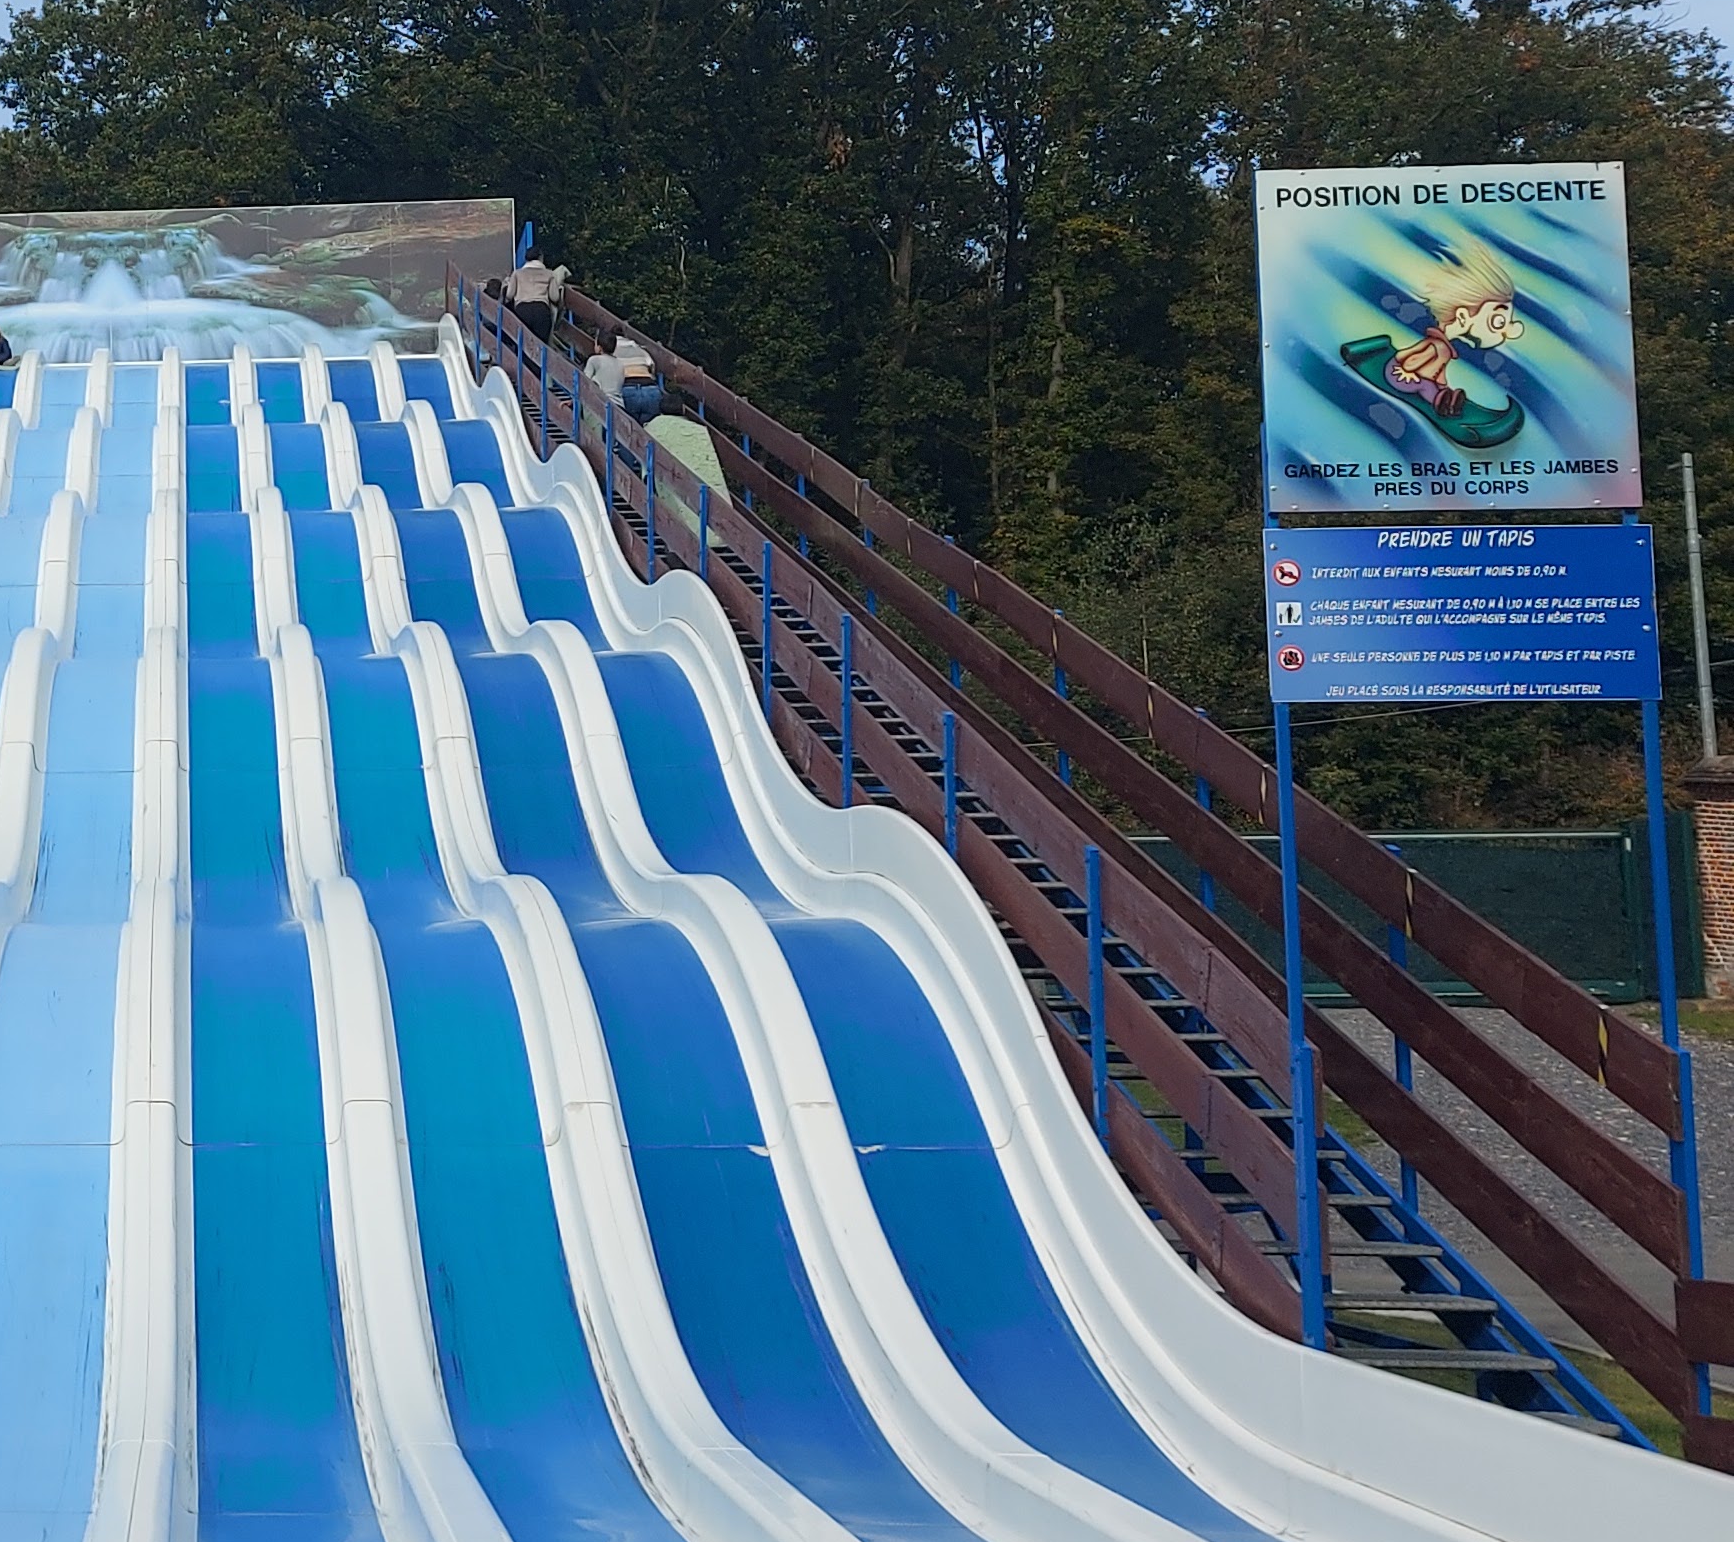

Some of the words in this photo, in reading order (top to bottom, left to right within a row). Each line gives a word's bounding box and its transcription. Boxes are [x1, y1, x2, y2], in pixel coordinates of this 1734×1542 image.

[1276, 185, 1401, 208] POSITION
[1414, 184, 1449, 205] DE
[1461, 180, 1607, 204] DESCENTE
[1284, 463, 1360, 478] GARDEZ
[1368, 463, 1403, 477] LES
[1411, 462, 1461, 477] BRAS
[1469, 461, 1494, 476] ET
[1500, 460, 1536, 475] LES
[1543, 459, 1619, 475] JAMBES
[1374, 481, 1422, 497] PRES
[1431, 481, 1455, 495] DU
[1465, 480, 1530, 495] CORPS
[1377, 531, 1453, 549] PRENDRE
[1461, 529, 1482, 547] UN
[1486, 529, 1535, 547] TAPIS
[1312, 567, 1359, 579] INTERDIT
[1362, 567, 1380, 577] AUX
[1383, 566, 1428, 578] ENFANTS
[1430, 565, 1482, 577] MESURANT
[1485, 565, 1515, 577] MOINS
[1516, 565, 1530, 576] DE
[1310, 599, 1349, 611] CHAQUE
[1352, 598, 1389, 611] ENFANT
[1392, 598, 1444, 610] MESURANT
[1446, 599, 1461, 610] DE
[1534, 597, 1550, 609] SE
[1551, 597, 1583, 609] PLACE
[1584, 597, 1617, 608] ENTRE
[1620, 597, 1641, 608] LES
[1309, 614, 1348, 626] JAMBES
[1351, 614, 1364, 625] DE
[1366, 614, 1413, 626] L'ADULTE
[1415, 614, 1433, 625] QUI
[1434, 613, 1507, 625] L'ACCOMPAGNE
[1508, 612, 1529, 624] SUR
[1531, 612, 1544, 624] LE
[1311, 652, 1330, 663] UNE
[1332, 651, 1365, 663] SEULE
[1368, 650, 1420, 662] PERSONNE
[1422, 651, 1437, 662] DE
[1439, 650, 1466, 662] PLUS
[1467, 650, 1483, 662] DE
[1511, 650, 1532, 662] PAR
[1534, 650, 1564, 661] TAPIS
[1566, 650, 1580, 661] ET
[1582, 650, 1602, 661] PAR
[1326, 685, 1345, 697] JEU
[1381, 684, 1410, 696] SOUS
[1411, 685, 1425, 696] LA
[1513, 684, 1527, 695] DE
